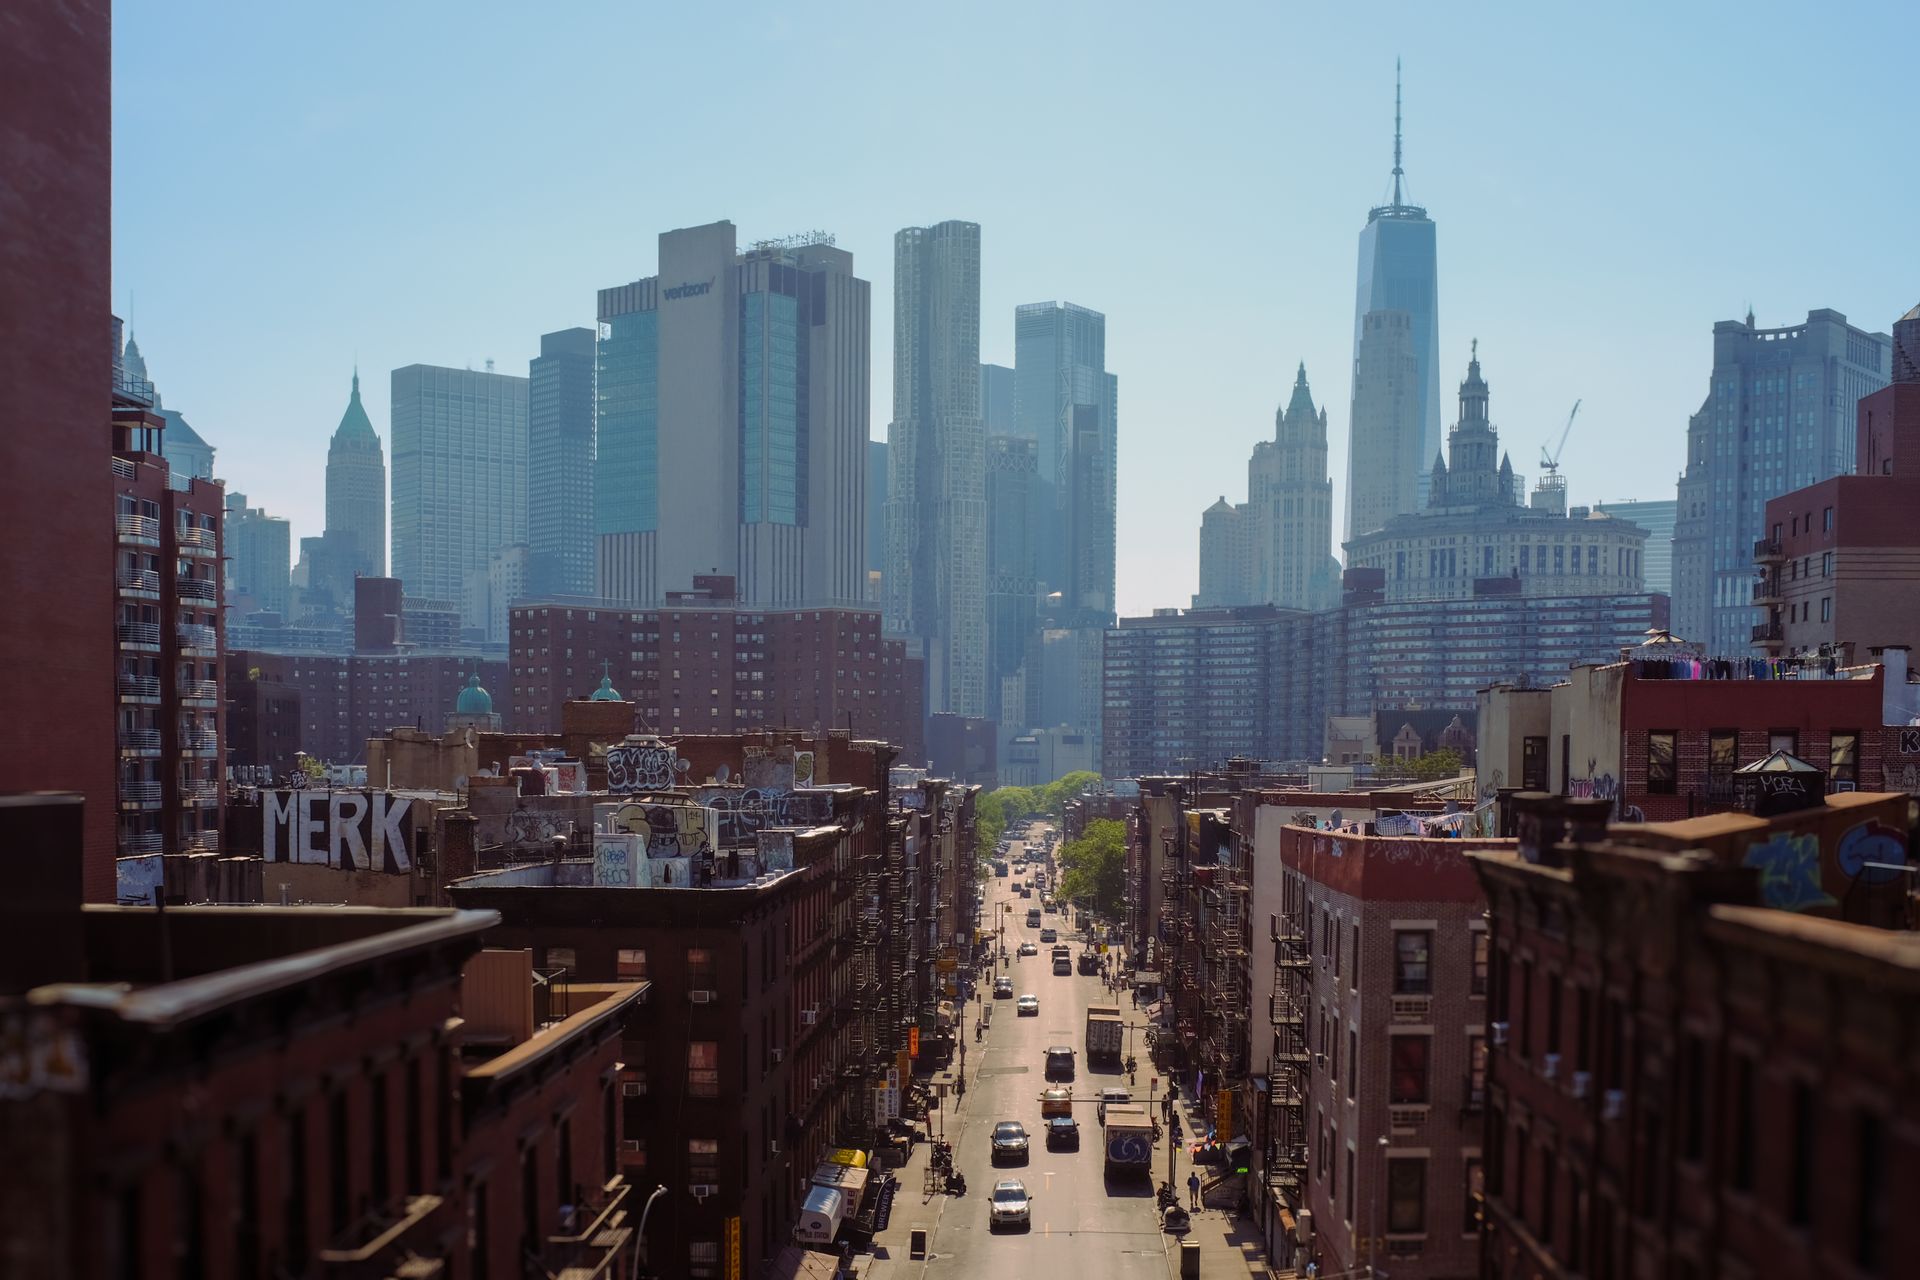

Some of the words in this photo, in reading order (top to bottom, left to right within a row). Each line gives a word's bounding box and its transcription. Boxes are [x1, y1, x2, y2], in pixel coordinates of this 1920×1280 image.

[663, 282, 709, 301] verizon
[262, 790, 413, 874] MERK
[877, 1189, 891, 1229] BREWERY
